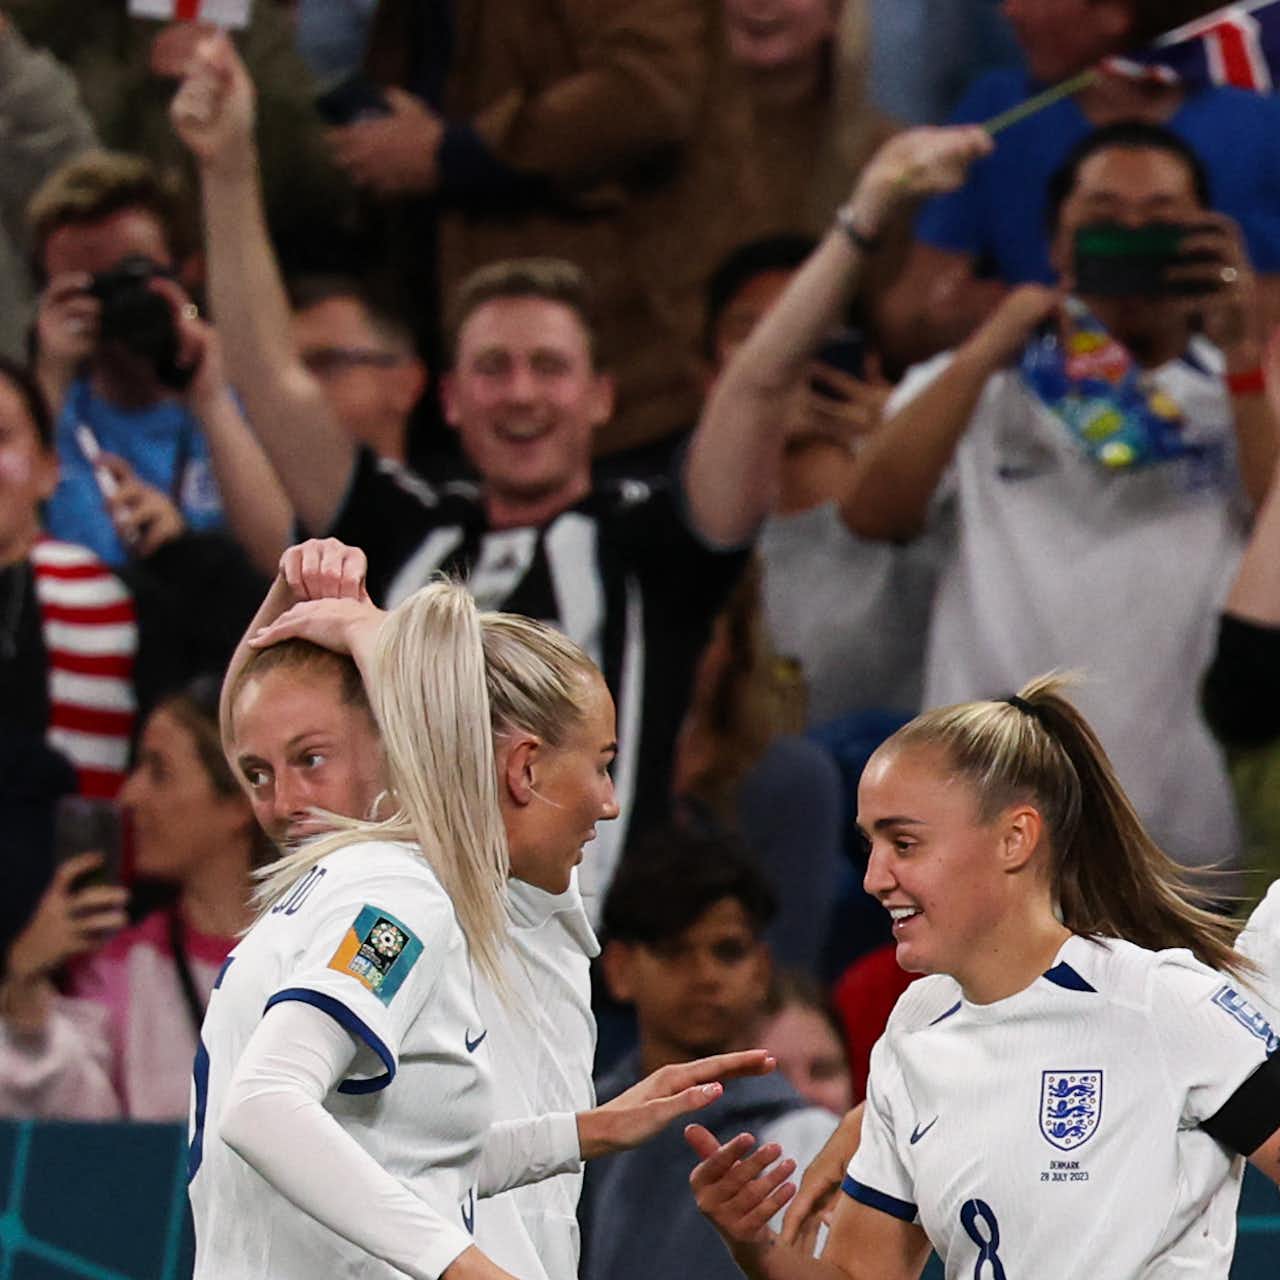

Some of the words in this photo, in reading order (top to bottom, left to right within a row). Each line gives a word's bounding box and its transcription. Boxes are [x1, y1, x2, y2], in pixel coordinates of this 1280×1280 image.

[1050, 1160, 1080, 1170] DENMARK
[1052, 1171, 1068, 1181] JULY
[1070, 1171, 1089, 1181] 2023
